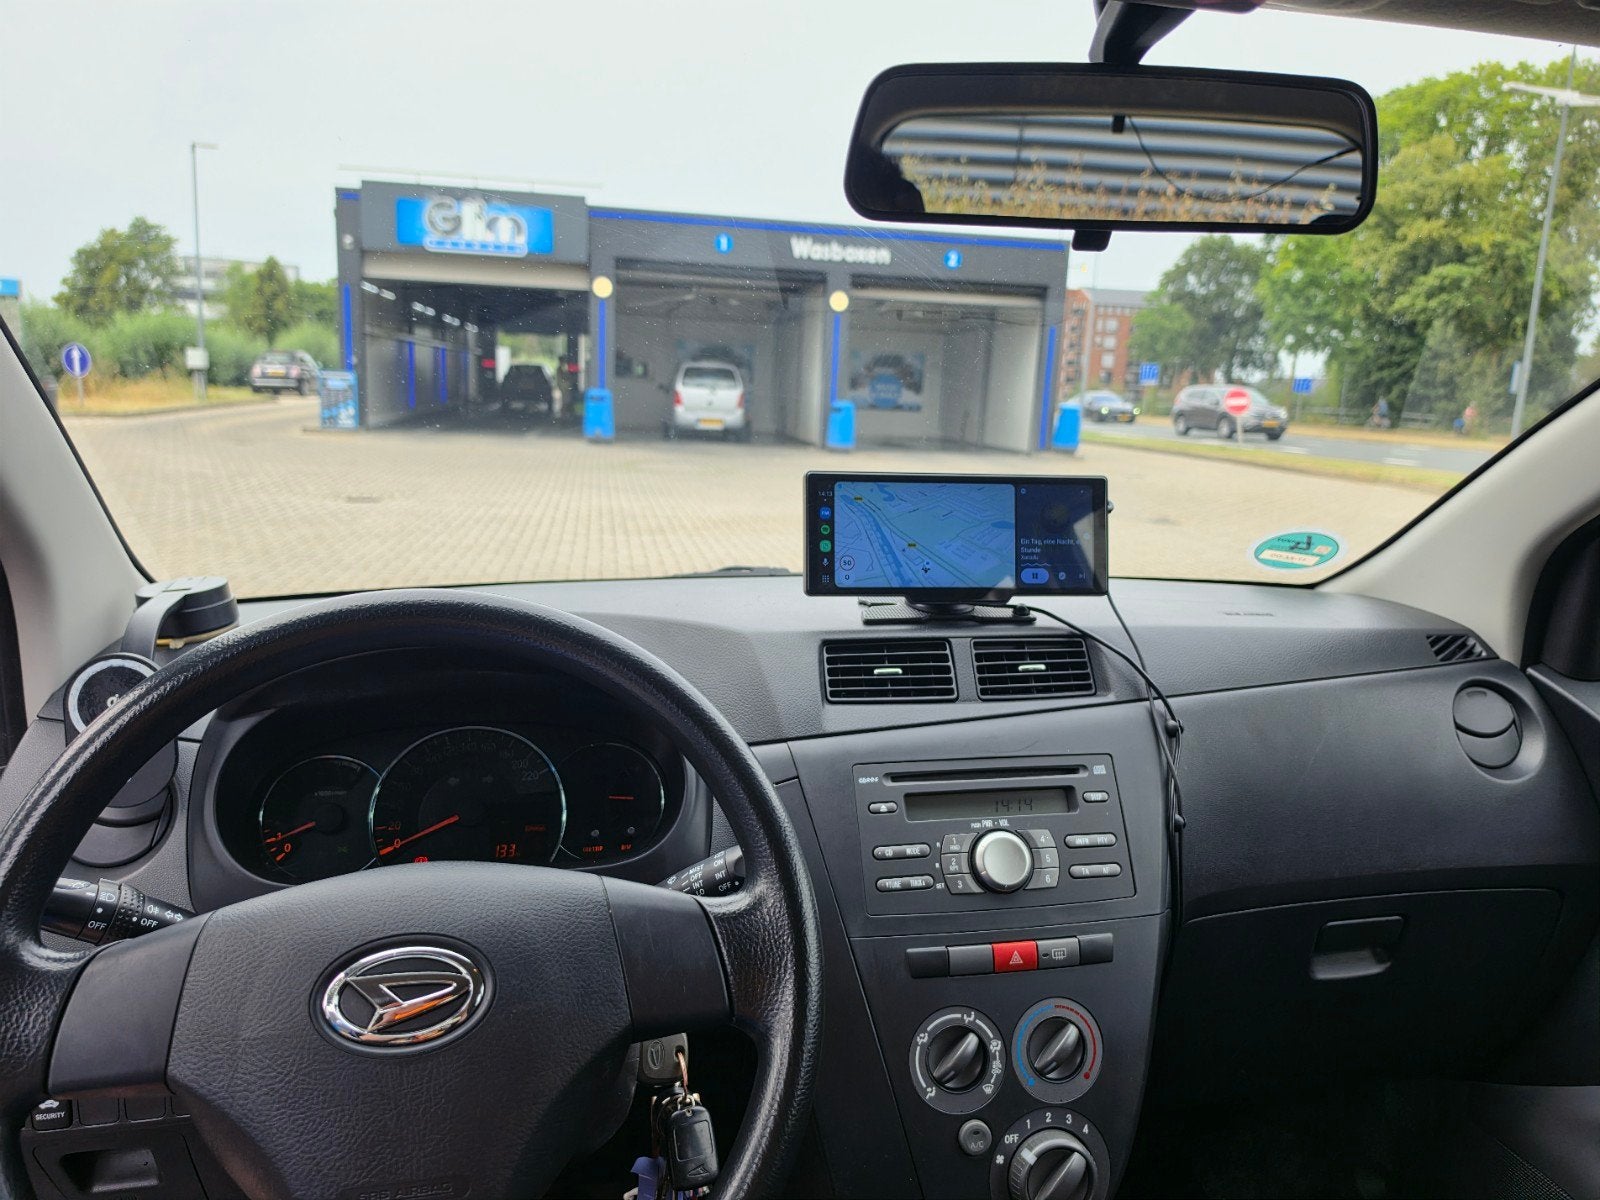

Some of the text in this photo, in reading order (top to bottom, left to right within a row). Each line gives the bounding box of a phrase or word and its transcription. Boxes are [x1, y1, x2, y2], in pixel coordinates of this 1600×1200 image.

[720, 237, 727, 252] 1
[790, 234, 892, 266] Wasboxen
[948, 250, 957, 267] 2
[995, 798, 1033, 813] 14:14
[998, 818, 1010, 827] VOL
[952, 837, 956, 845] 1
[1039, 834, 1045, 843] 4
[283, 842, 292, 853] 0
[495, 842, 517, 859] 133
[884, 848, 894, 857] CD
[713, 858, 724, 867] ON
[951, 857, 956, 865] 2
[1045, 854, 1051, 863] 5
[690, 872, 703, 882] OFF
[715, 870, 726, 880] INT
[1045, 874, 1051, 884] 6
[692, 880, 704, 890] INT
[718, 881, 732, 892] OFF
[957, 879, 963, 889] 3
[88, 920, 107, 931] OFF
[141, 918, 159, 928] OFF
[35, 1111, 66, 1121] SECURITY
[1045, 1112, 1052, 1123] 2
[1065, 1113, 1072, 1124] 3
[1025, 1118, 1031, 1129] 1
[1082, 1124, 1089, 1134] 4
[1004, 1133, 1019, 1144] OFF
[970, 1140, 984, 1150] A/C
